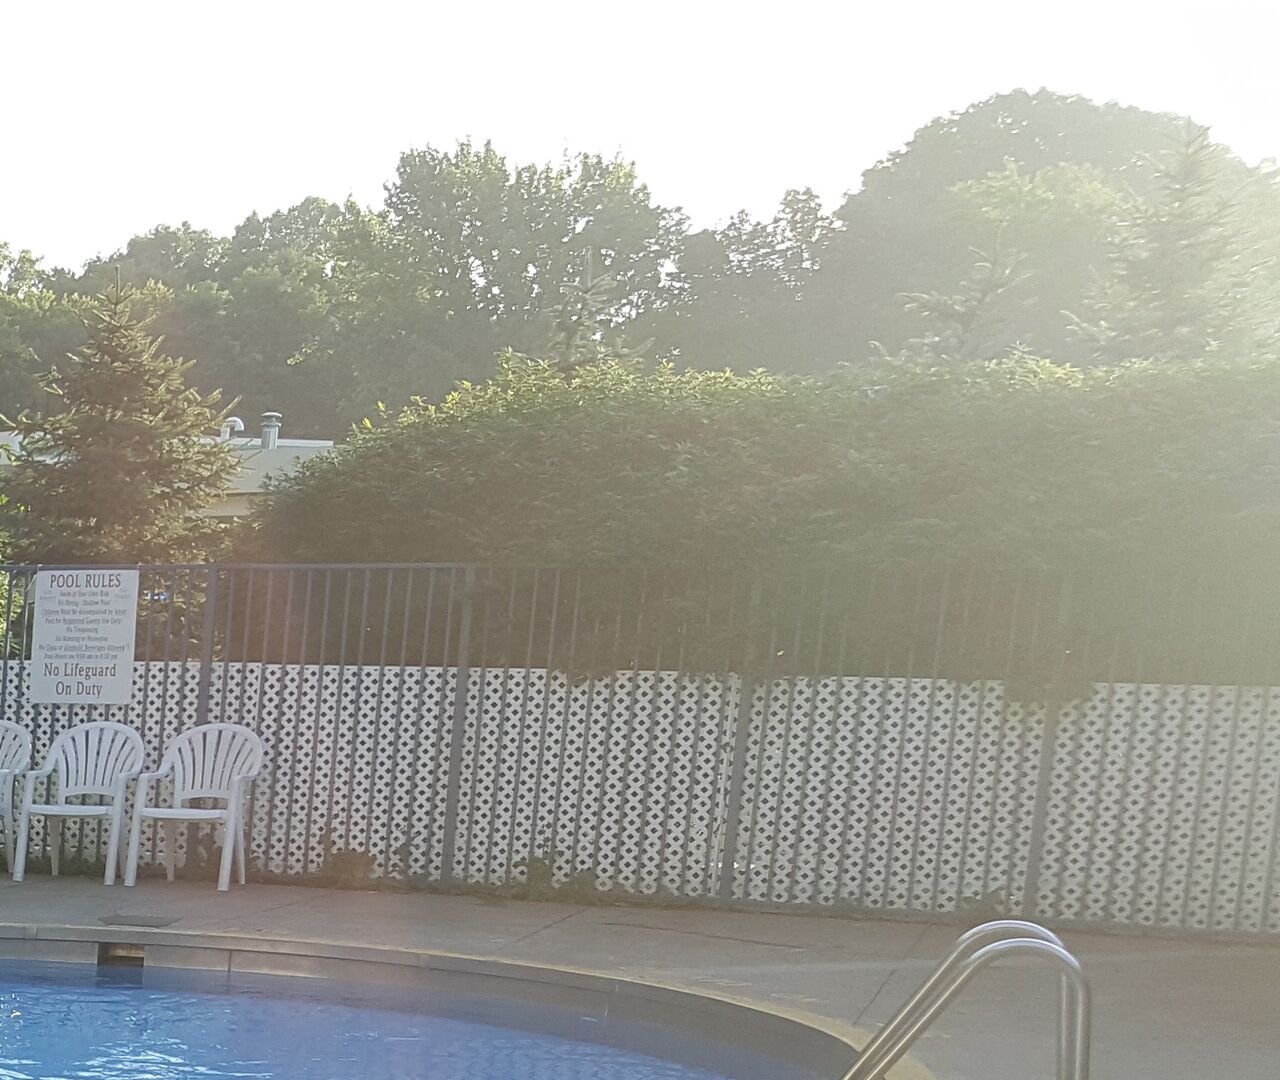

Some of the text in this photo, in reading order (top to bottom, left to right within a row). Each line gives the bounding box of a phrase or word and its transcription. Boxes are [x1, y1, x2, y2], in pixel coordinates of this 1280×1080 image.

[50, 573, 121, 588] POOL RULES
[44, 662, 116, 680] No Lifeguard
[56, 681, 102, 699] On Duty
